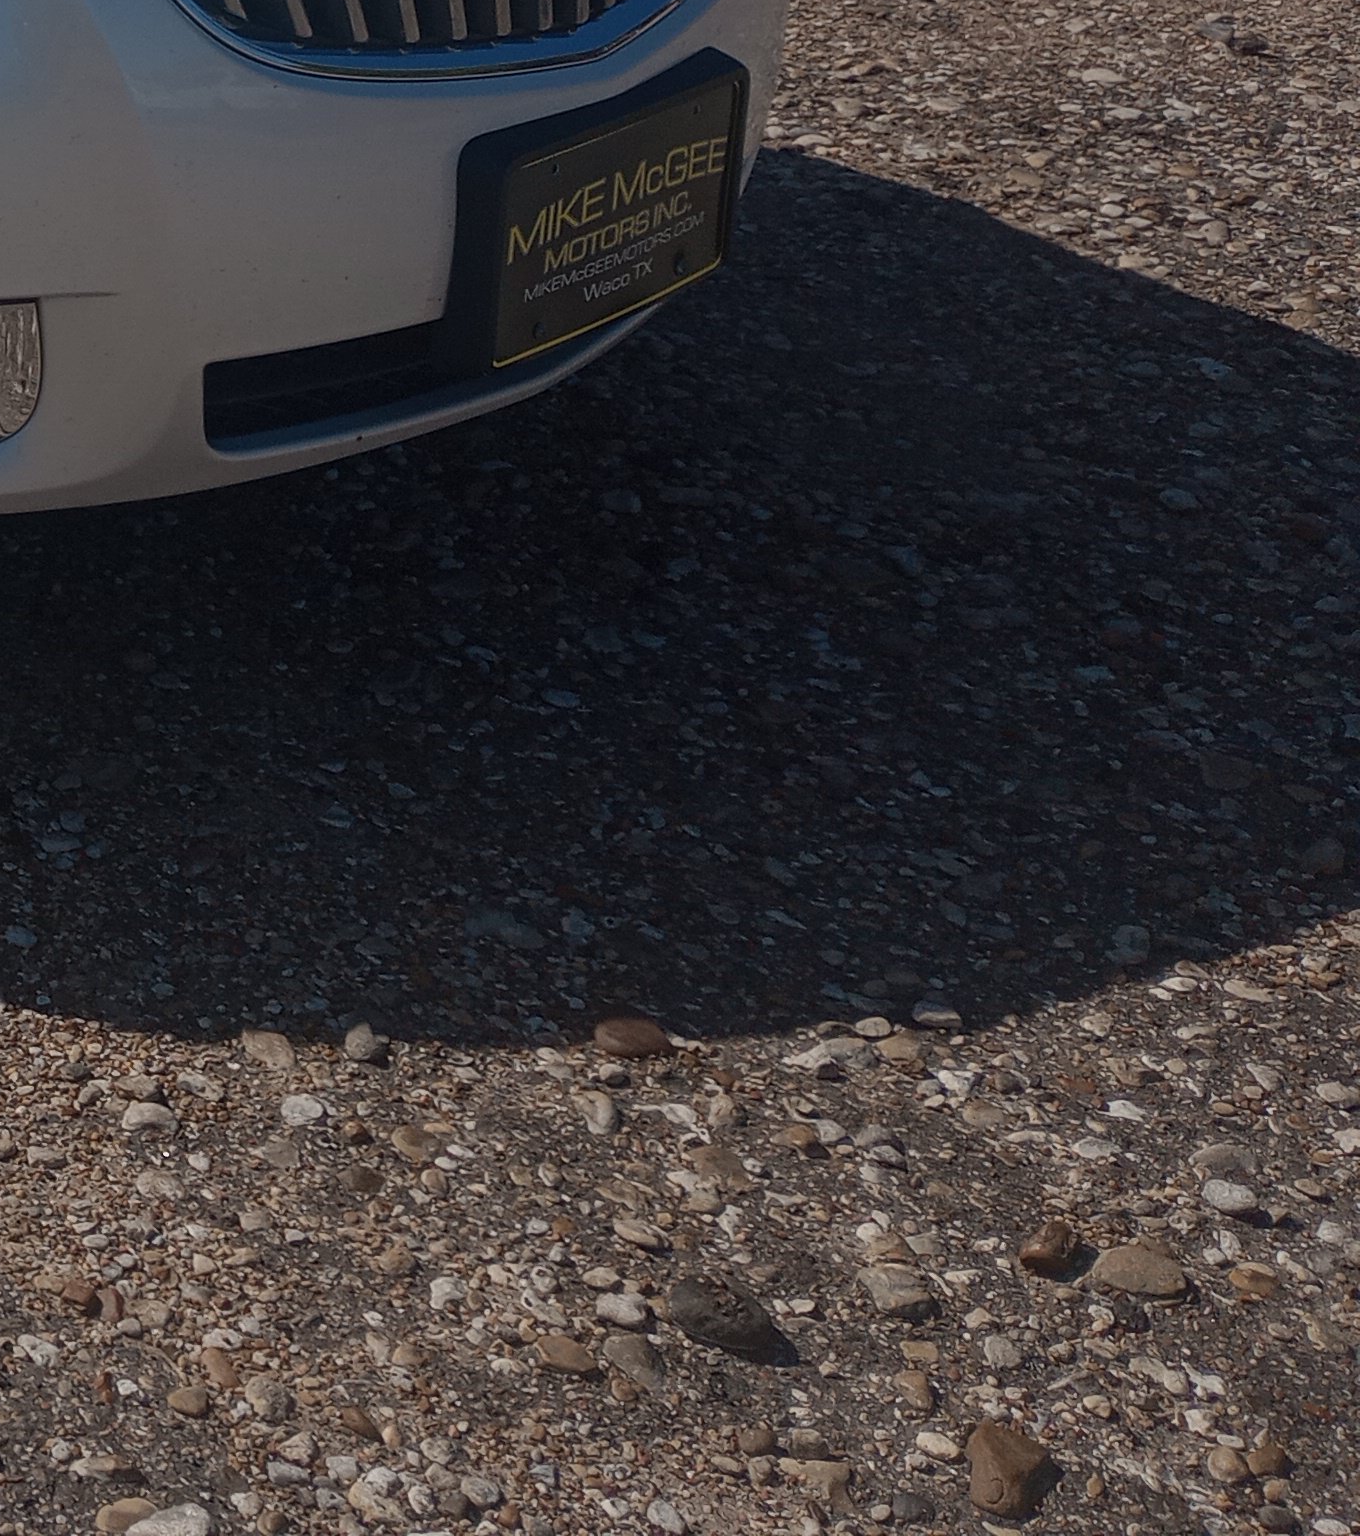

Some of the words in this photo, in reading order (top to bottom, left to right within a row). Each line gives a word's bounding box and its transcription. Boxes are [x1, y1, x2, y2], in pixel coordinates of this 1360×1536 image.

[506, 177, 606, 266] MIKE
[612, 135, 728, 211] McGEE
[543, 209, 651, 274] MOTORS
[652, 190, 693, 228] INC.
[583, 275, 630, 303] Waco
[631, 257, 655, 281] TX
